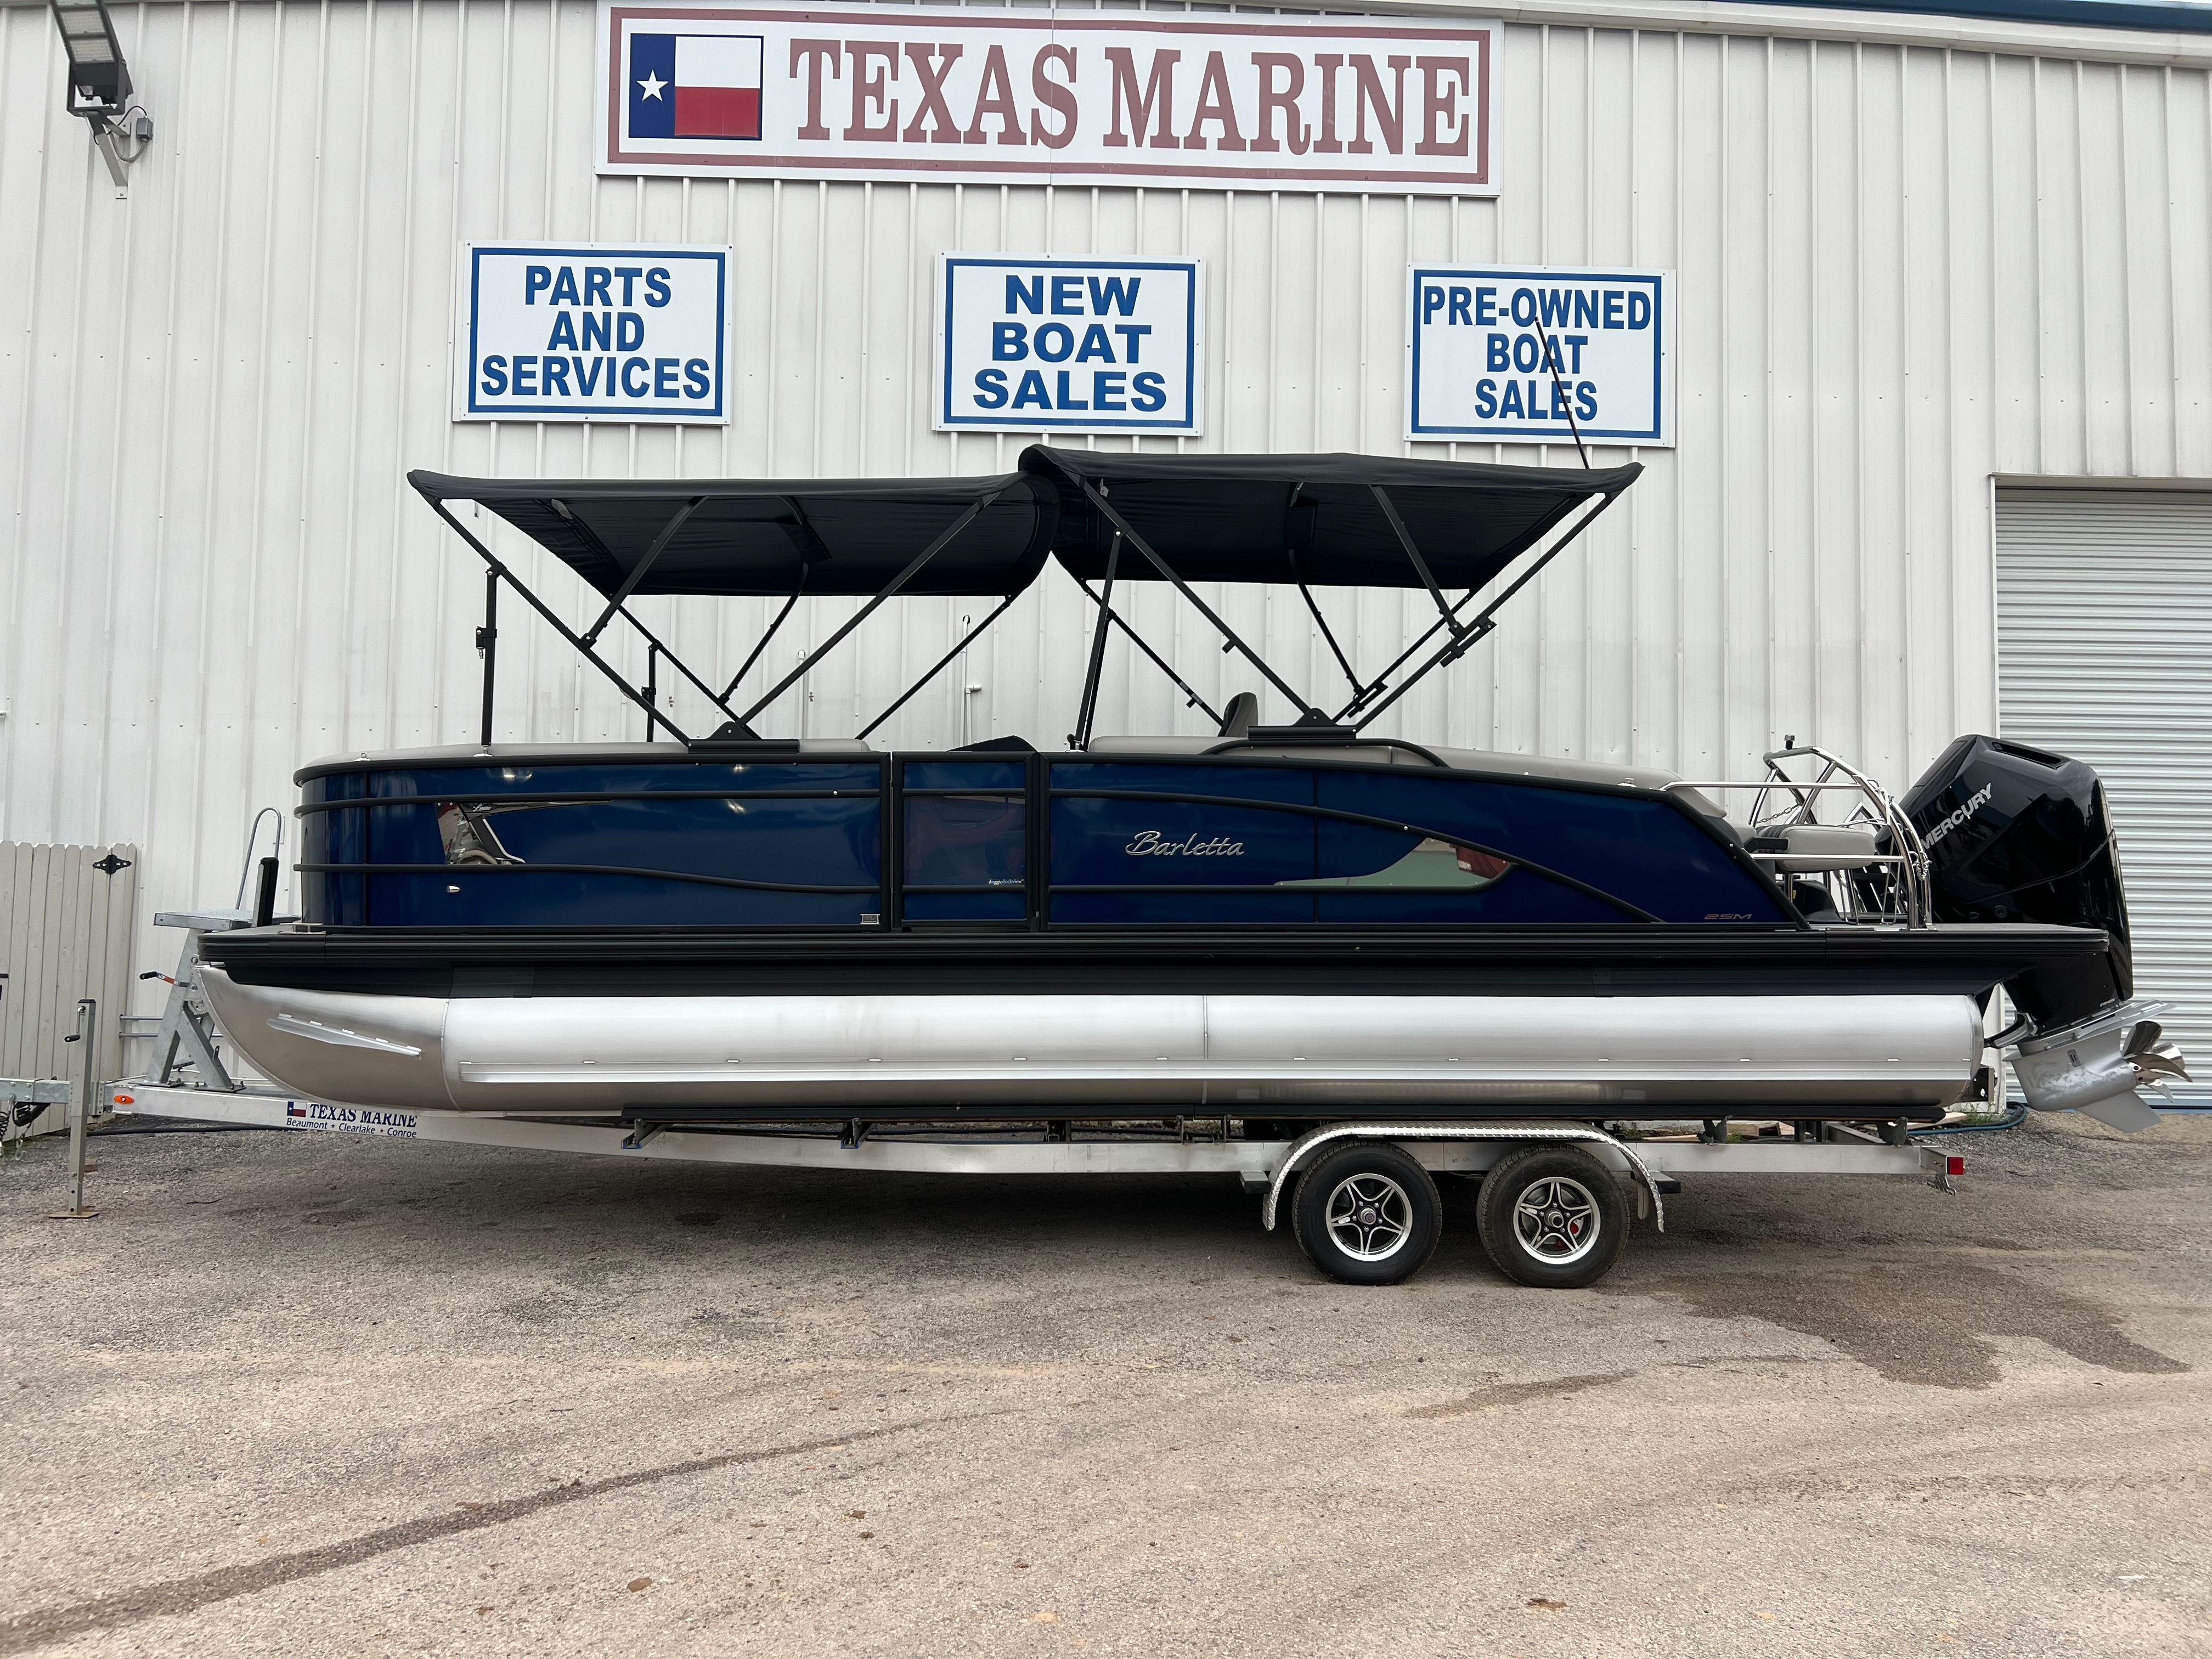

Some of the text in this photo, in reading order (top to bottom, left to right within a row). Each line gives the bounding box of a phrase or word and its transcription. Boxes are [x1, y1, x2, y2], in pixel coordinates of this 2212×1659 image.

[789, 38, 1469, 157] TEXAS MARINE
[524, 265, 672, 308] PARTS
[1005, 274, 1141, 317] NEW
[1423, 285, 1651, 330] PRE-OWNED
[546, 311, 645, 352] AND
[992, 321, 1152, 364] BOAT
[1487, 332, 1588, 374] BOAT
[481, 354, 710, 399] SERVICES
[973, 368, 1167, 412] SALES
[1474, 379, 1598, 421] SALES
[1920, 782, 1991, 850] MERCURY
[1125, 830, 1245, 856] Barletta
[286, 1118, 417, 1138] Beaumont Clearlake Conroe
[309, 1103, 417, 1128] TEXAS MARINE
